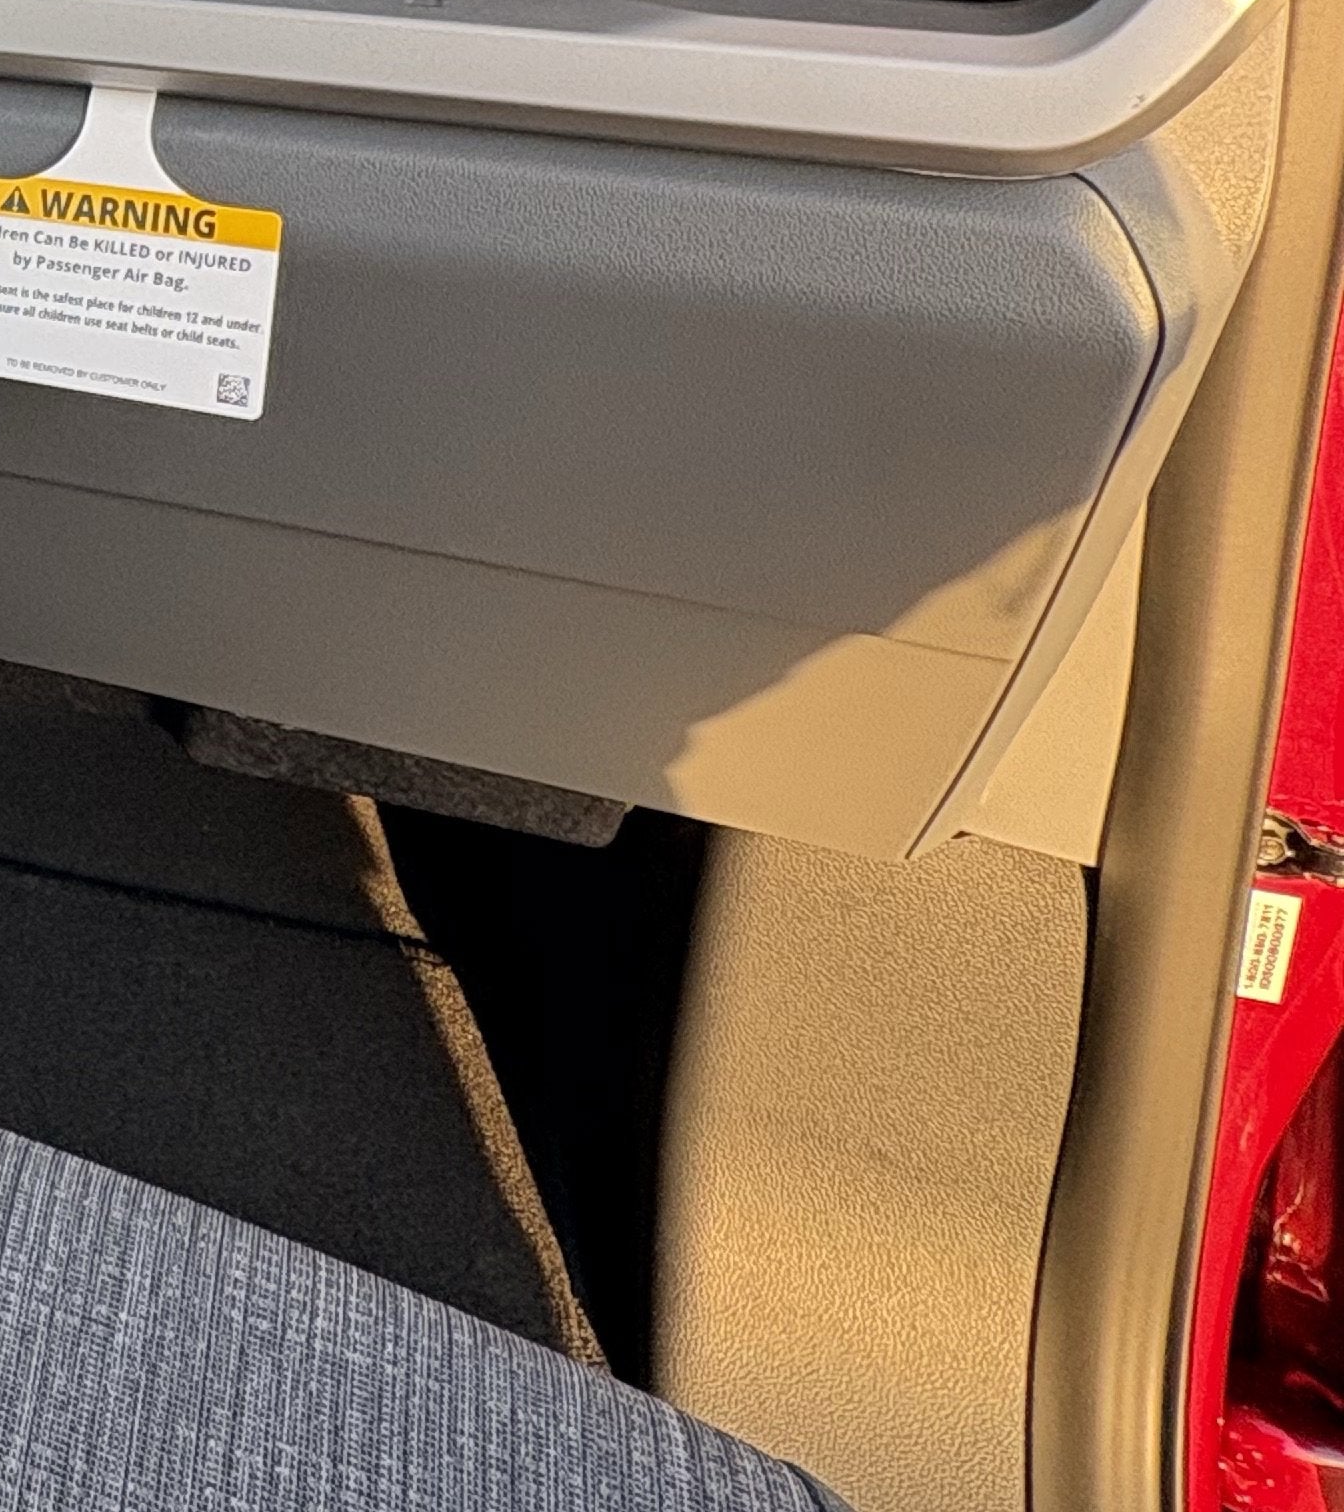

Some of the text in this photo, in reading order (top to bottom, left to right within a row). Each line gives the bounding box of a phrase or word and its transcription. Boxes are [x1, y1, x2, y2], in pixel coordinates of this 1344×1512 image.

[41, 188, 217, 239] WARNING
[12, 252, 189, 292] by Passenger Air Bag.
[34, 230, 64, 248] Can
[68, 235, 90, 252] Be
[94, 238, 150, 260] KILLED
[154, 248, 174, 262] or
[178, 250, 252, 274] INJURED
[21, 286, 30, 298] is
[32, 288, 50, 302] the
[52, 292, 84, 307] safest
[86, 296, 114, 312] place
[118, 300, 134, 314] for
[136, 304, 182, 322] children
[186, 311, 199, 324] 12
[201, 315, 224, 328] and
[22, 306, 36, 318] all
[38, 308, 82, 325] children
[84, 316, 102, 328] use
[105, 319, 128, 332] seat
[131, 321, 158, 337] belts
[160, 328, 174, 339] or
[176, 328, 204, 344] child
[206, 335, 241, 350] seats.
[6, 357, 18, 368] TO
[20, 359, 30, 370] BE
[33, 361, 75, 377] REMOVED
[77, 368, 88, 379] BY
[90, 371, 140, 388] CUSTOMER
[141, 379, 167, 392] ONLY
